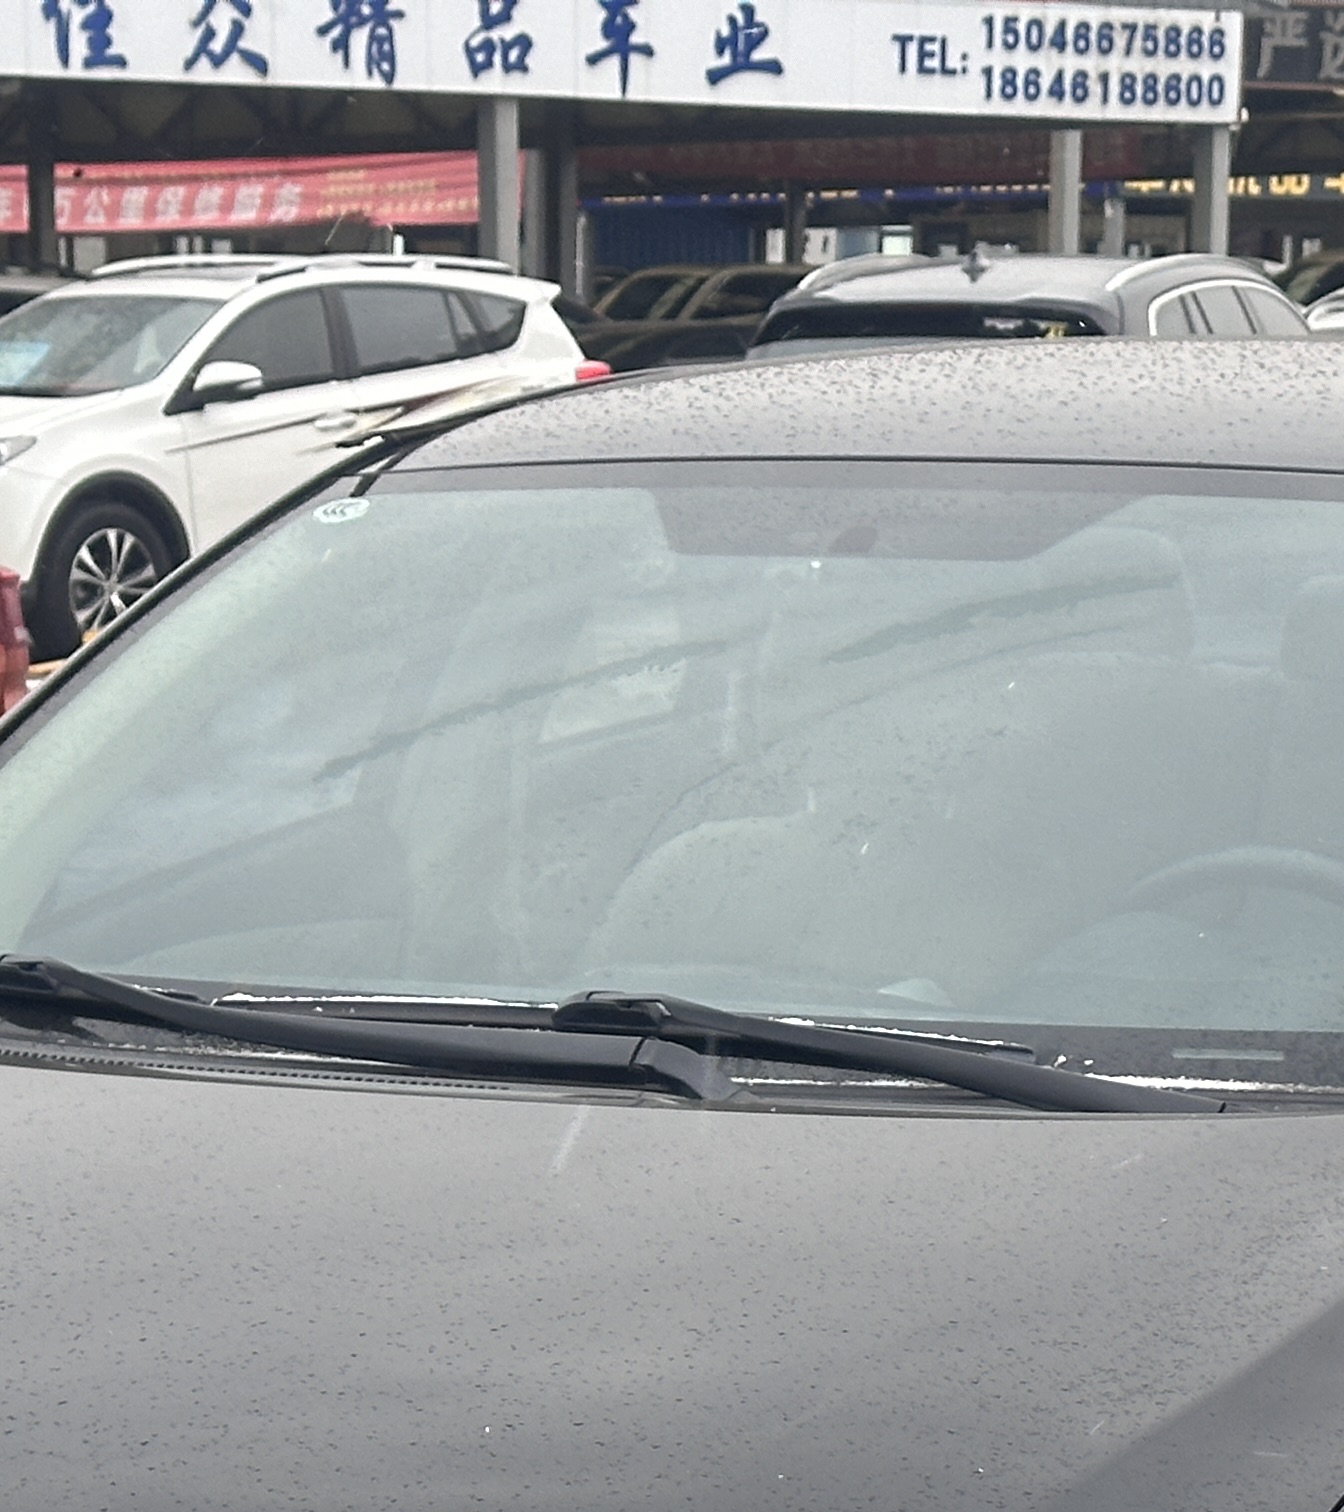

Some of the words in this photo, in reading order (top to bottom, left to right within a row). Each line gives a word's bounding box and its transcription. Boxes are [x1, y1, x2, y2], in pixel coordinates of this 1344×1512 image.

[892, 34, 969, 75] TEL:
[981, 13, 1225, 61] 15046675866
[981, 65, 1224, 107] 18646188600
